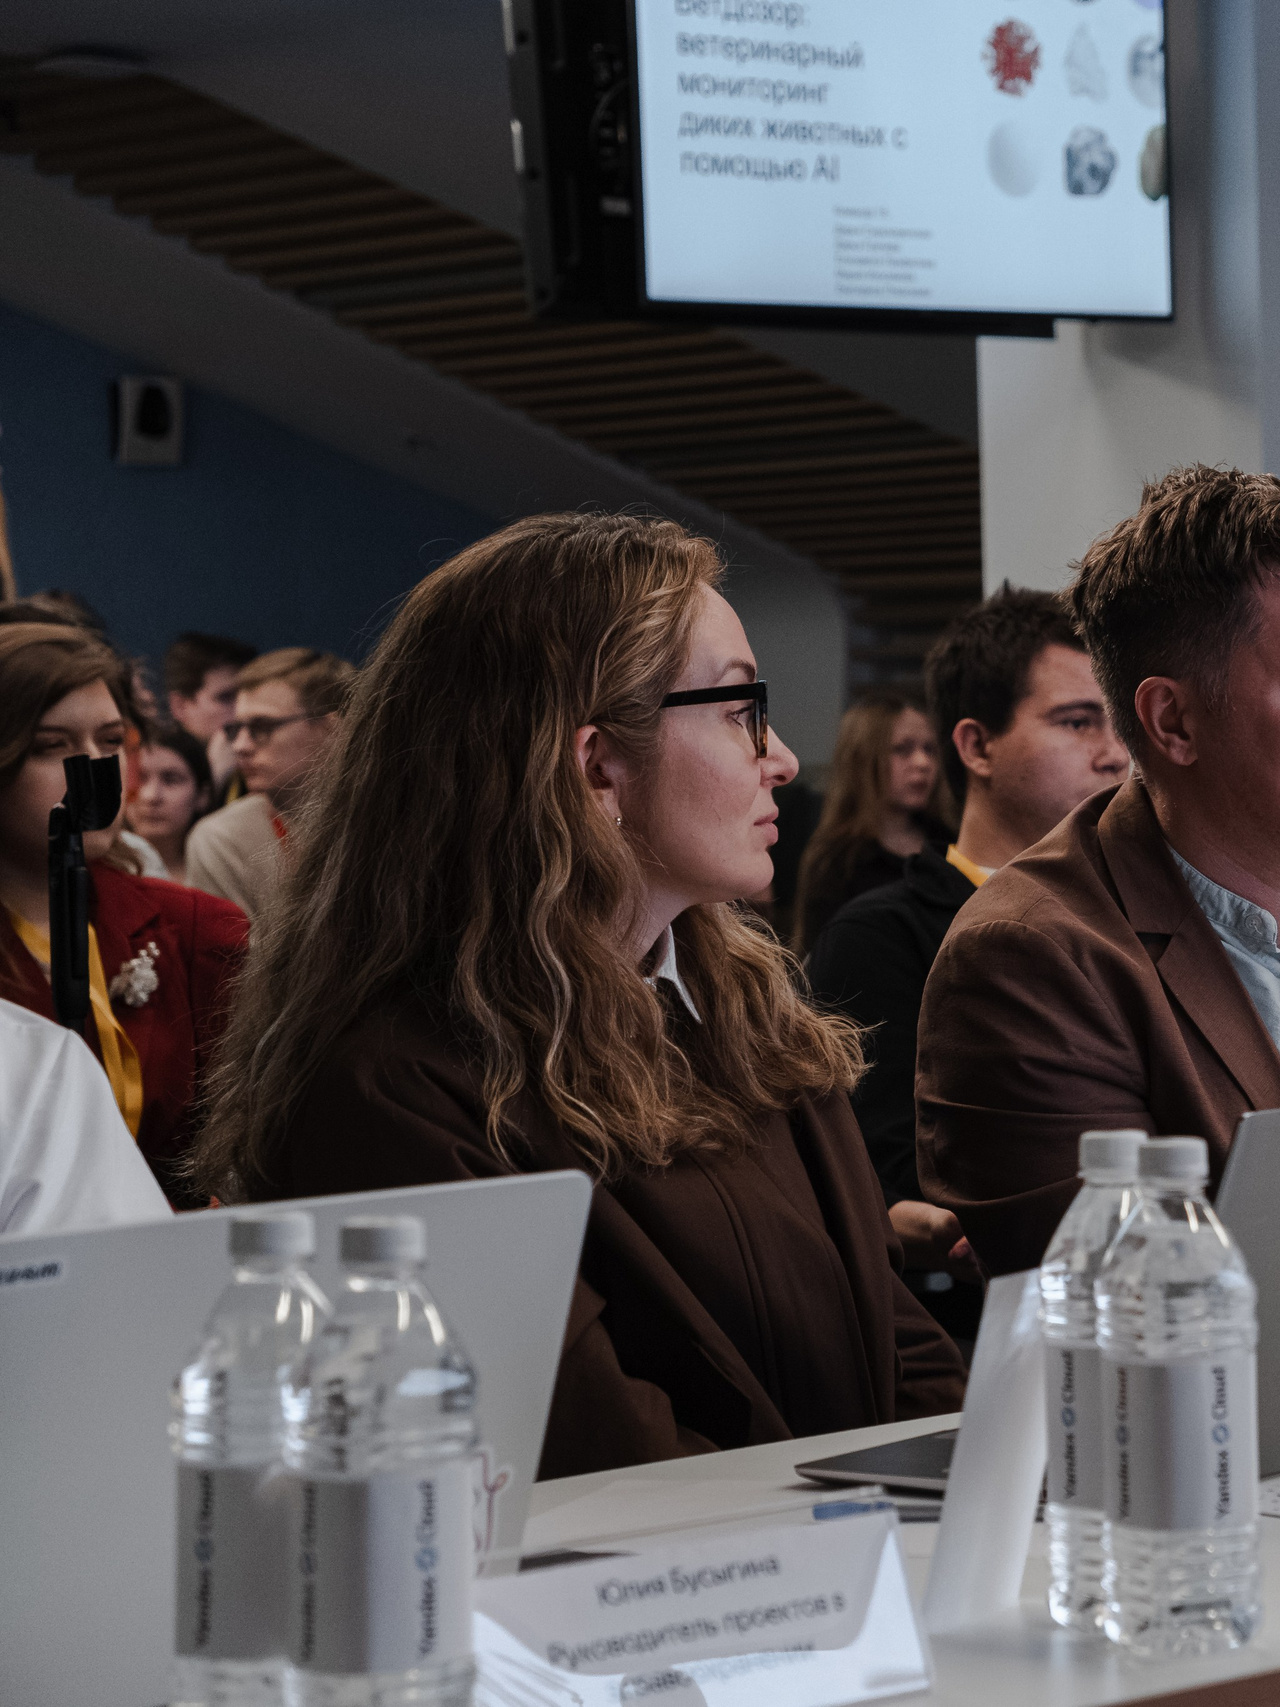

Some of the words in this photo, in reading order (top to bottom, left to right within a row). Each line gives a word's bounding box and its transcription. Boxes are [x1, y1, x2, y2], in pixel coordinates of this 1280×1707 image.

[677, 32, 864, 69] ветеринарный
[678, 73, 828, 105] мониторинг
[762, 118, 886, 146] животных
[891, 126, 908, 149] с
[680, 152, 807, 181] помощью
[1211, 1366, 1228, 1421] Cloud
[1063, 1432, 1077, 1499] Yandex
[1215, 1450, 1231, 1520] Yandex
[595, 1576, 666, 1608] Юлия
[667, 1554, 782, 1598] Бусыгина
[546, 1616, 721, 1668] Руководитель
[721, 1598, 830, 1637] проектов
